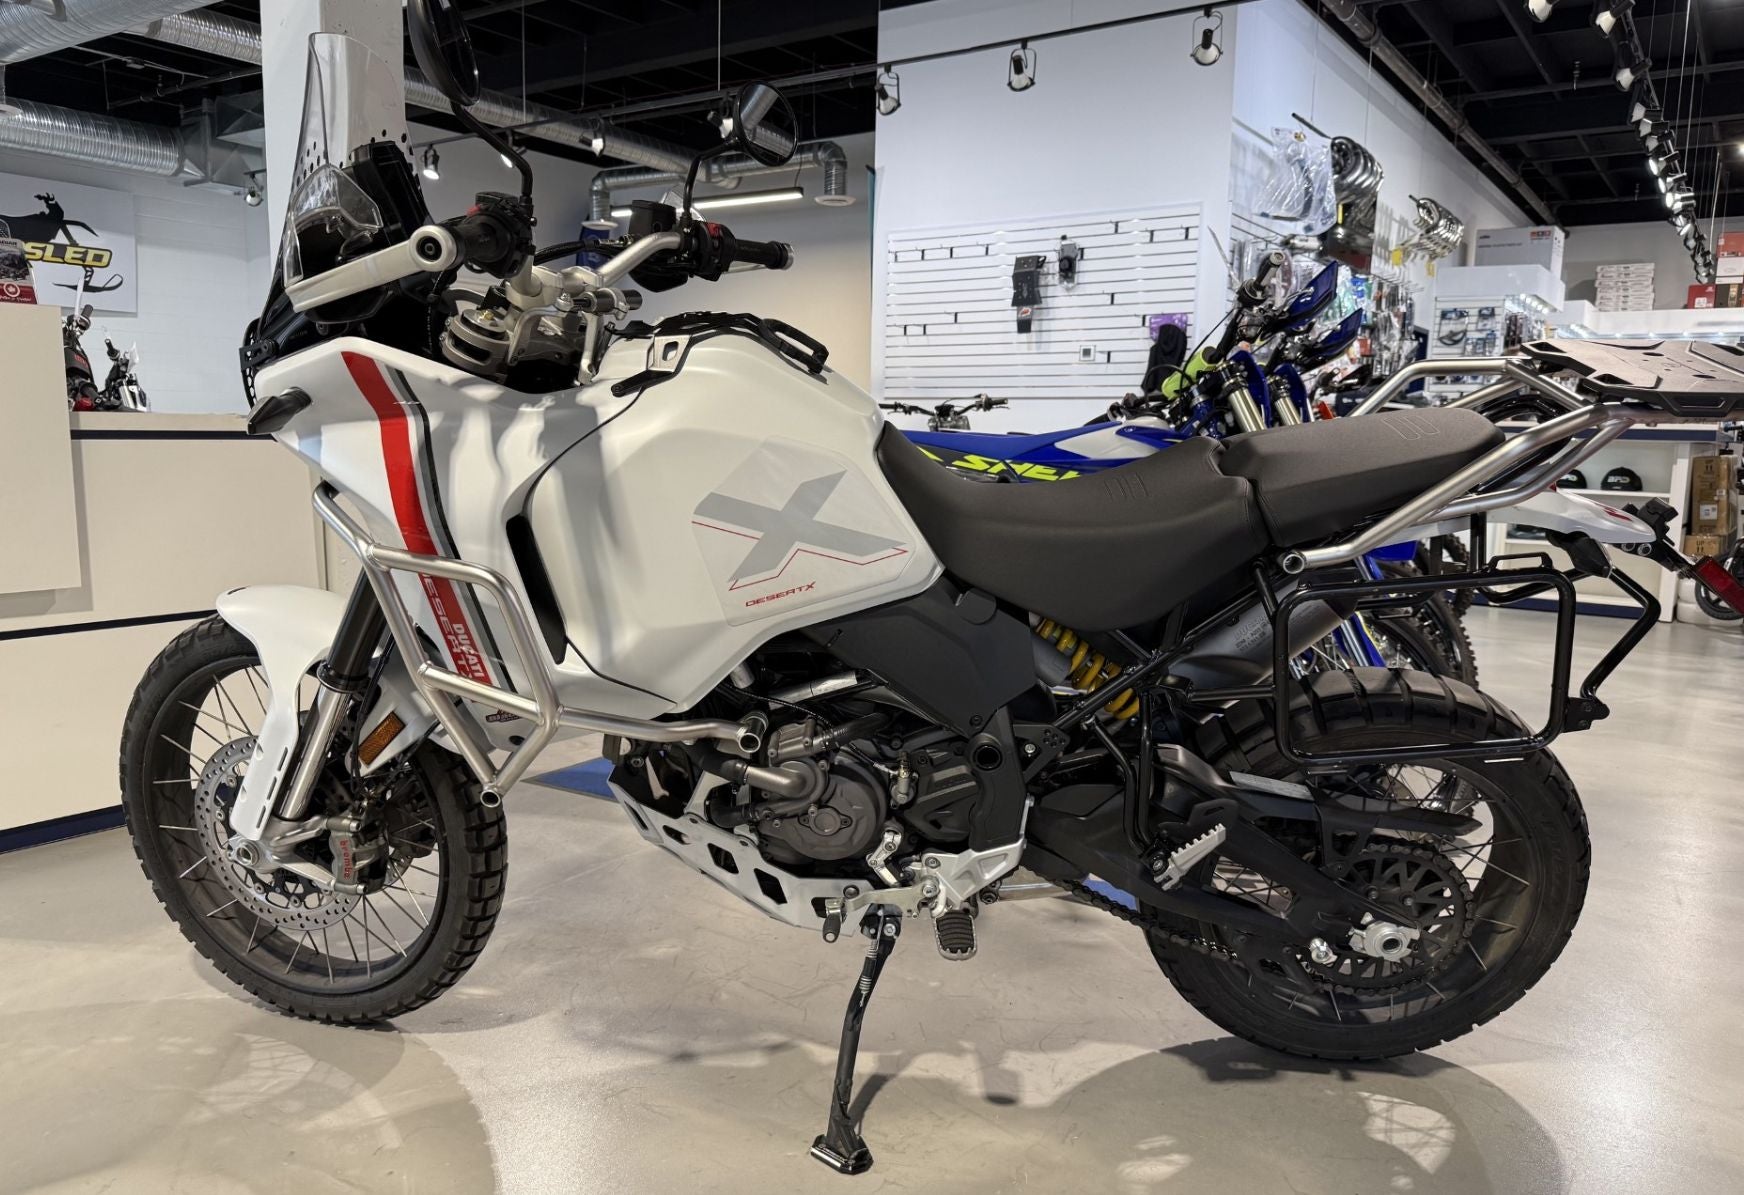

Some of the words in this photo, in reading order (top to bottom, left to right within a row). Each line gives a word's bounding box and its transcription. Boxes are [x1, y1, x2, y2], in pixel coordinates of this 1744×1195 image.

[24, 241, 112, 267] SLED
[745, 580, 816, 607] DESERTX
[452, 623, 486, 678] DUCATI
[340, 839, 353, 881] brembo
